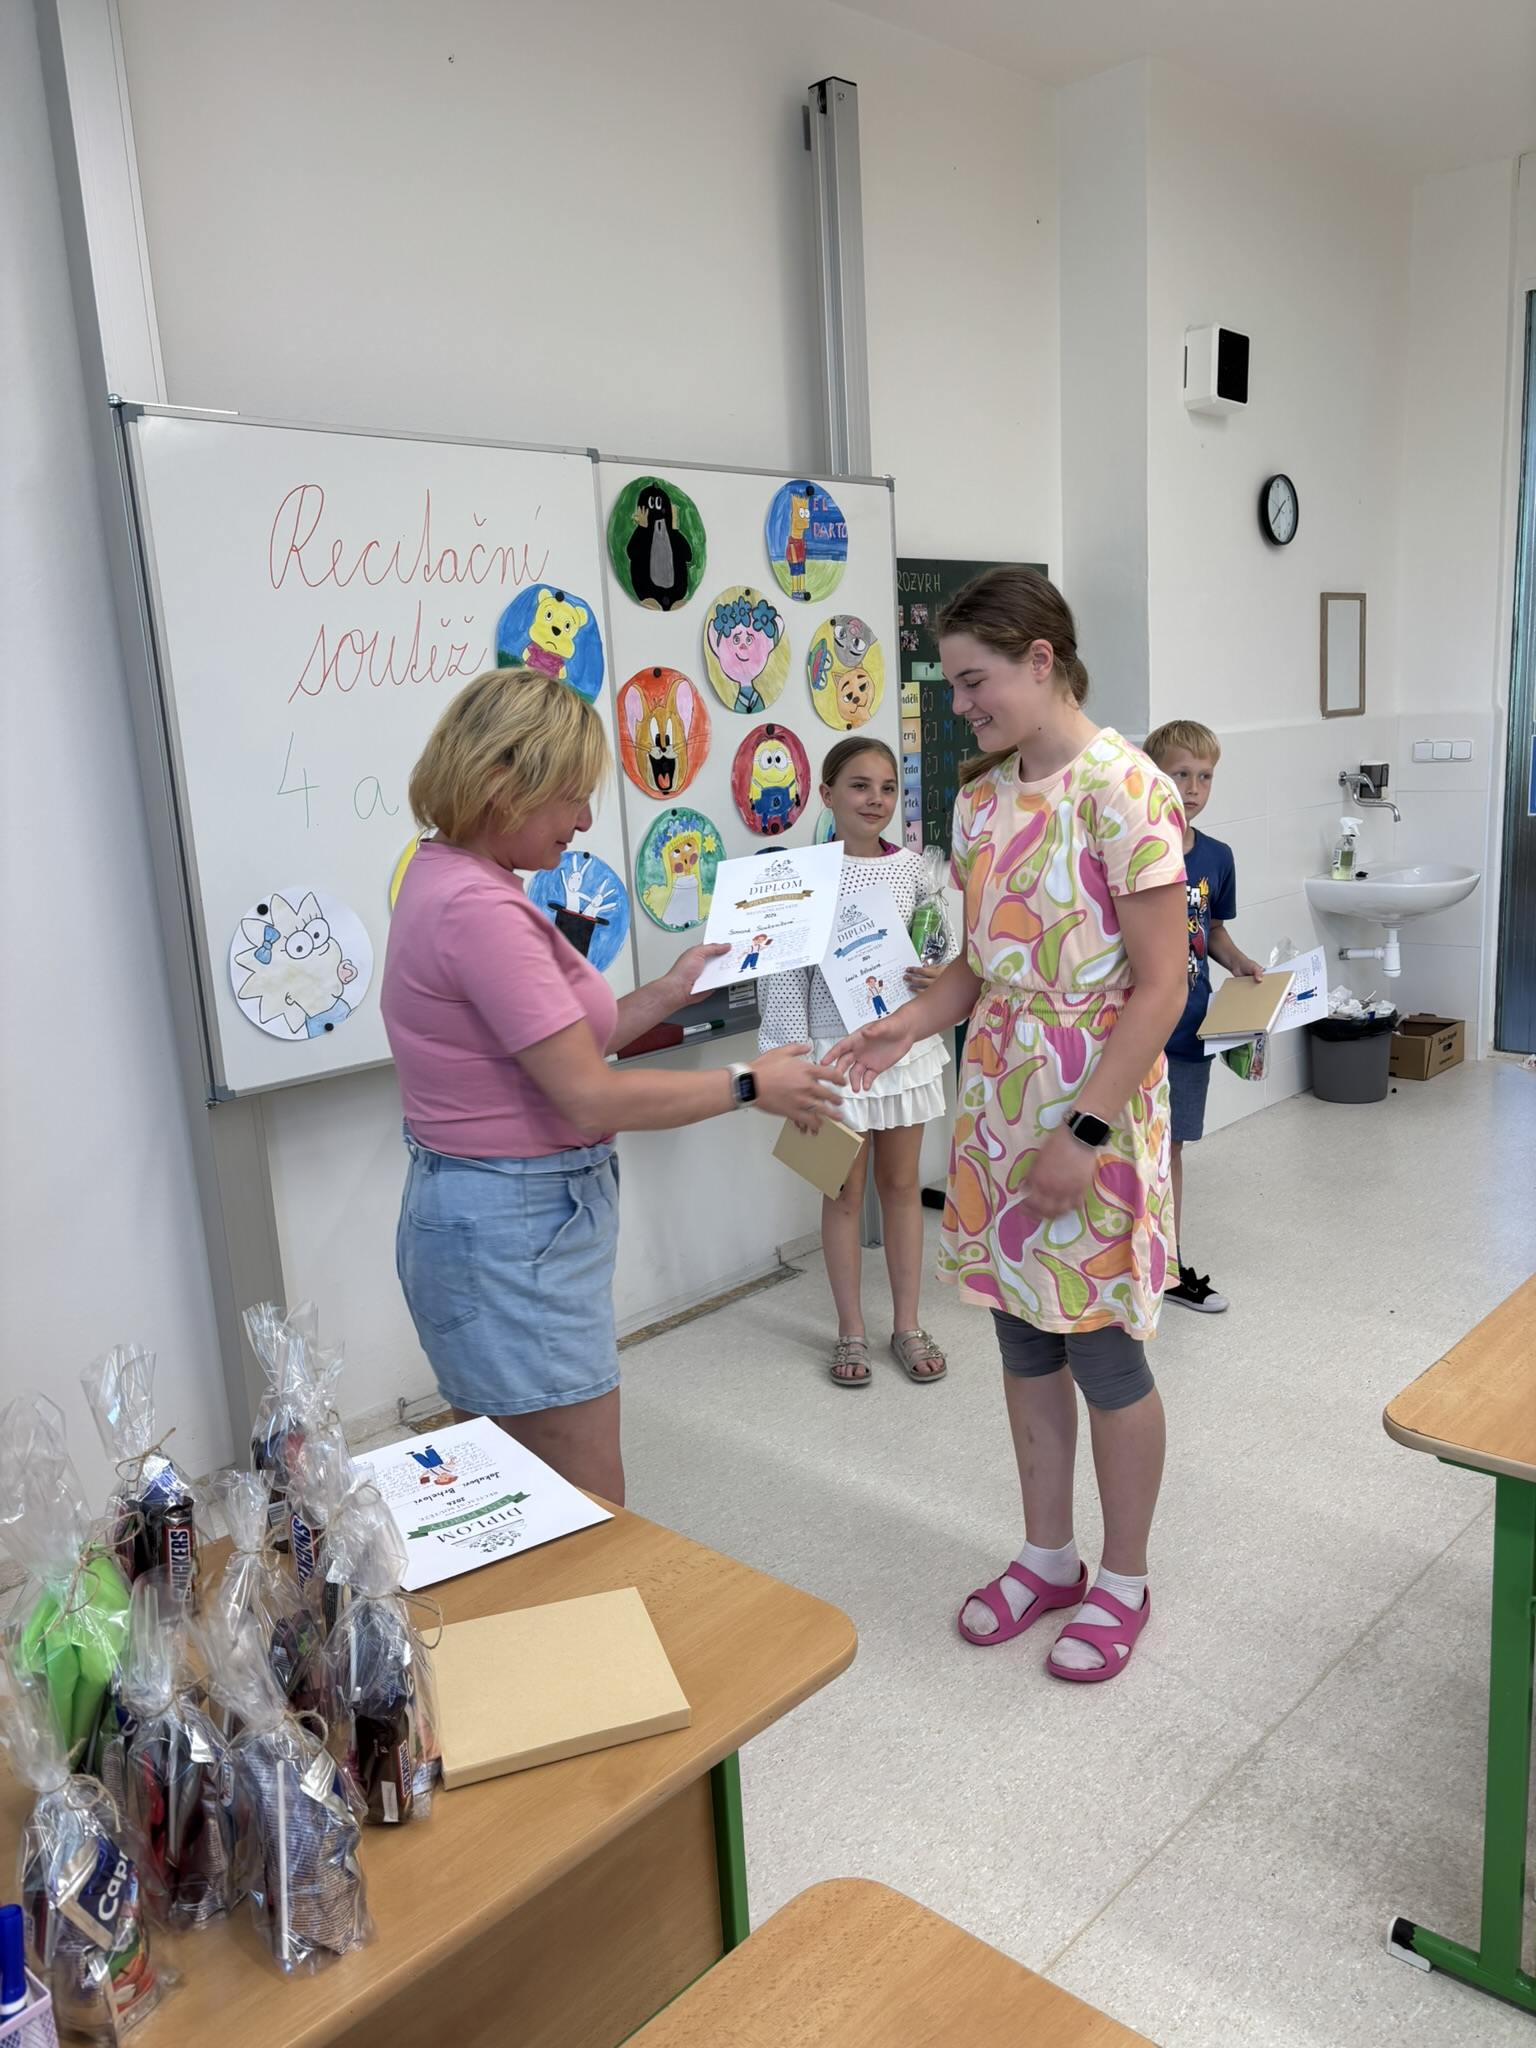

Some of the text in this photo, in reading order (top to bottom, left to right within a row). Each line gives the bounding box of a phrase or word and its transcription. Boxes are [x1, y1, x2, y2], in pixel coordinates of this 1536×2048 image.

[269, 484, 549, 590] Recitační
[289, 600, 487, 703] soutěž
[749, 879, 803, 895] DIPLOM
[836, 920, 876, 943] DIPLOM
[436, 1507, 523, 1542] DIPLOM
